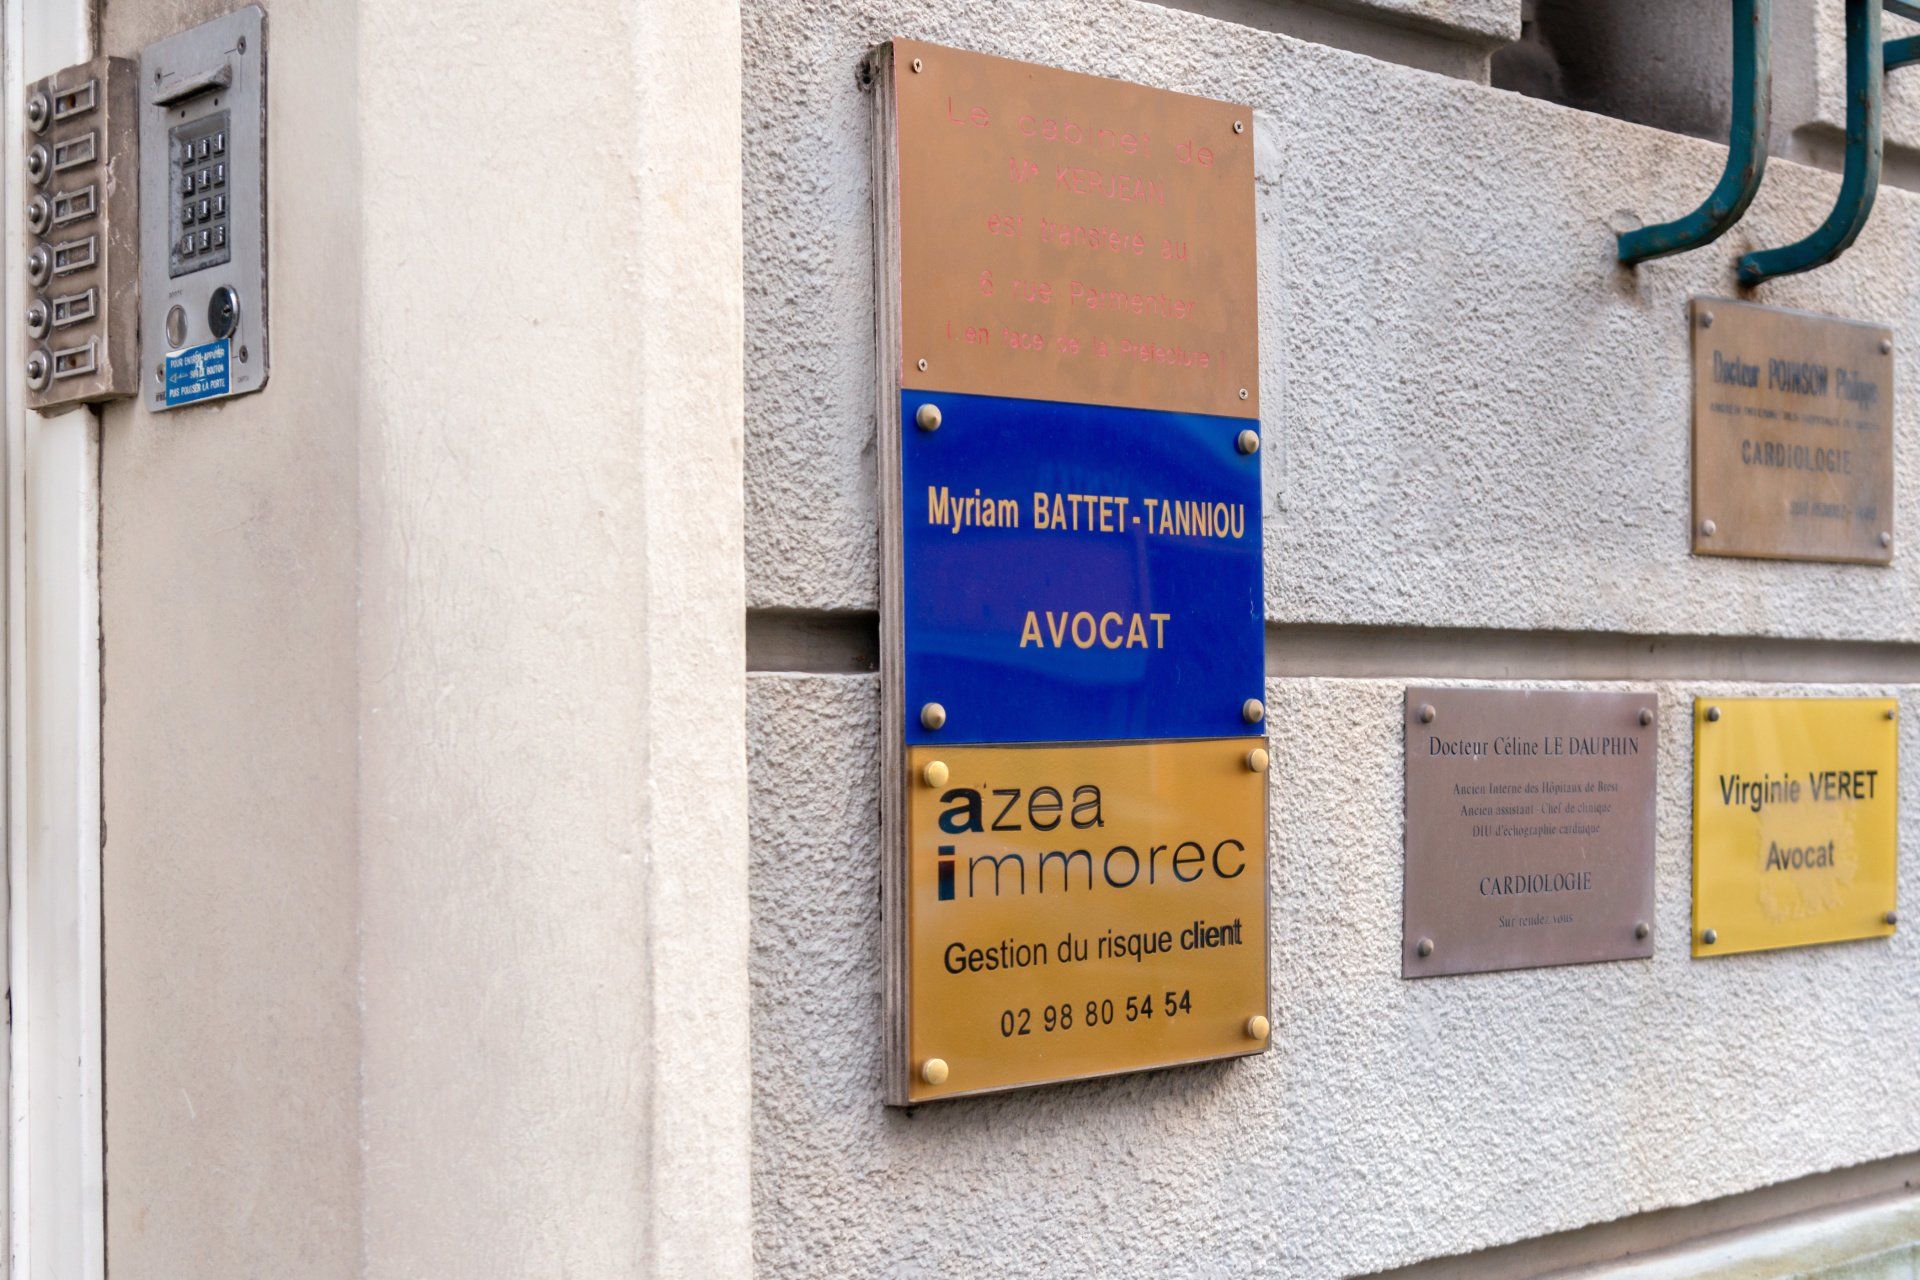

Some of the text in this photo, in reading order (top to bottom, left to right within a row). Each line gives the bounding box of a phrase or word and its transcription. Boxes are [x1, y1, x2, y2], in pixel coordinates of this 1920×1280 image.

[946, 96, 1214, 168] Le cabinet de
[1161, 239, 1188, 260] au
[979, 270, 1196, 320] 6 rue Parmentier
[1741, 439, 1852, 475] CARDIOLOGIE
[927, 485, 1019, 534] Myriam
[1019, 611, 1171, 649] AVOCAT
[1429, 735, 1639, 757] Docteur Céline LE DAUPHIN
[1453, 783, 1486, 796] Ancien
[1489, 782, 1522, 795] Interne
[1524, 781, 1540, 794] des
[1584, 781, 1595, 793] de
[1719, 769, 1878, 812] Virginie VERET
[937, 784, 1105, 835] azea
[1460, 804, 1493, 817] Ancien
[1565, 802, 1575, 814] de
[937, 838, 1246, 901] immorec
[1765, 840, 1835, 871] Avocat
[1480, 871, 1592, 896] CARDIOLOGIE
[1499, 914, 1517, 928] Sur
[1552, 913, 1573, 925] vous
[943, 917, 1243, 975] Gestion du risque client
[1000, 989, 1192, 1037] 02 98 80 54 54
